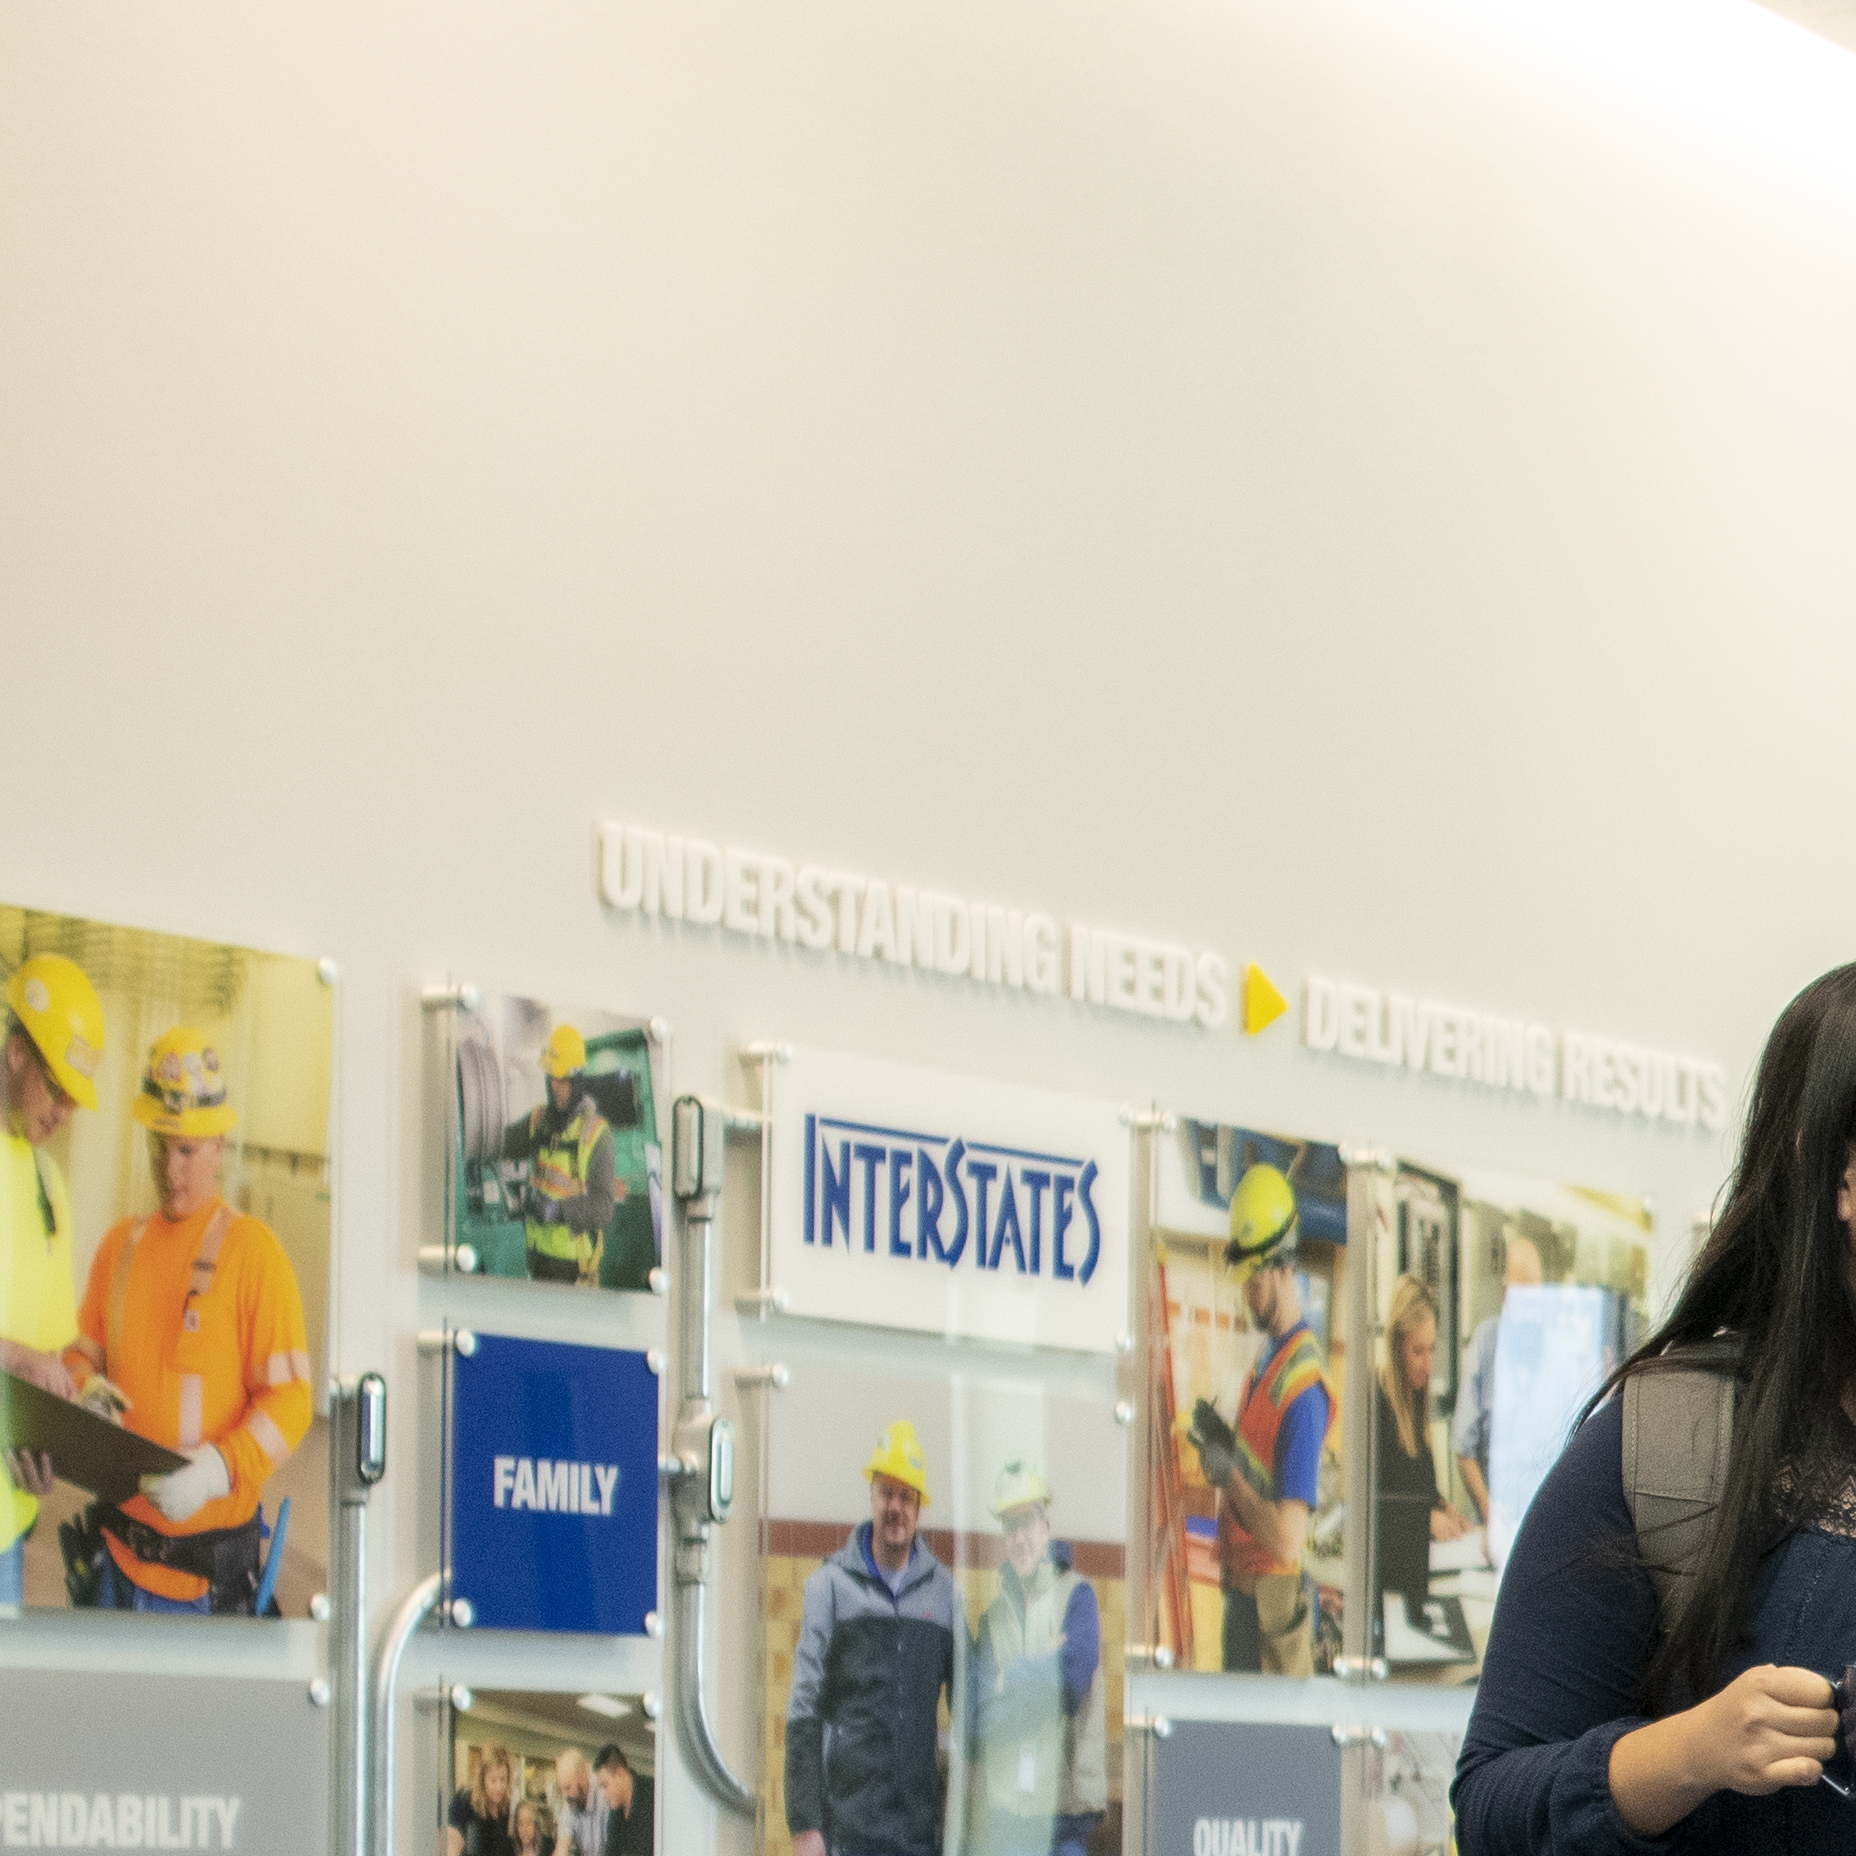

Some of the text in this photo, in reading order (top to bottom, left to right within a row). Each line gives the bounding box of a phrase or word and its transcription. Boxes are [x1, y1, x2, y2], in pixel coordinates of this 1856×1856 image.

[598, 822, 1725, 1130] UNDERSTANDING NEEDS DELIVERING RESULTS
[803, 1112, 1101, 1288] INTERSTATES
[494, 1454, 619, 1517] FAMILY
[0, 1790, 242, 1850] ENDABILITY
